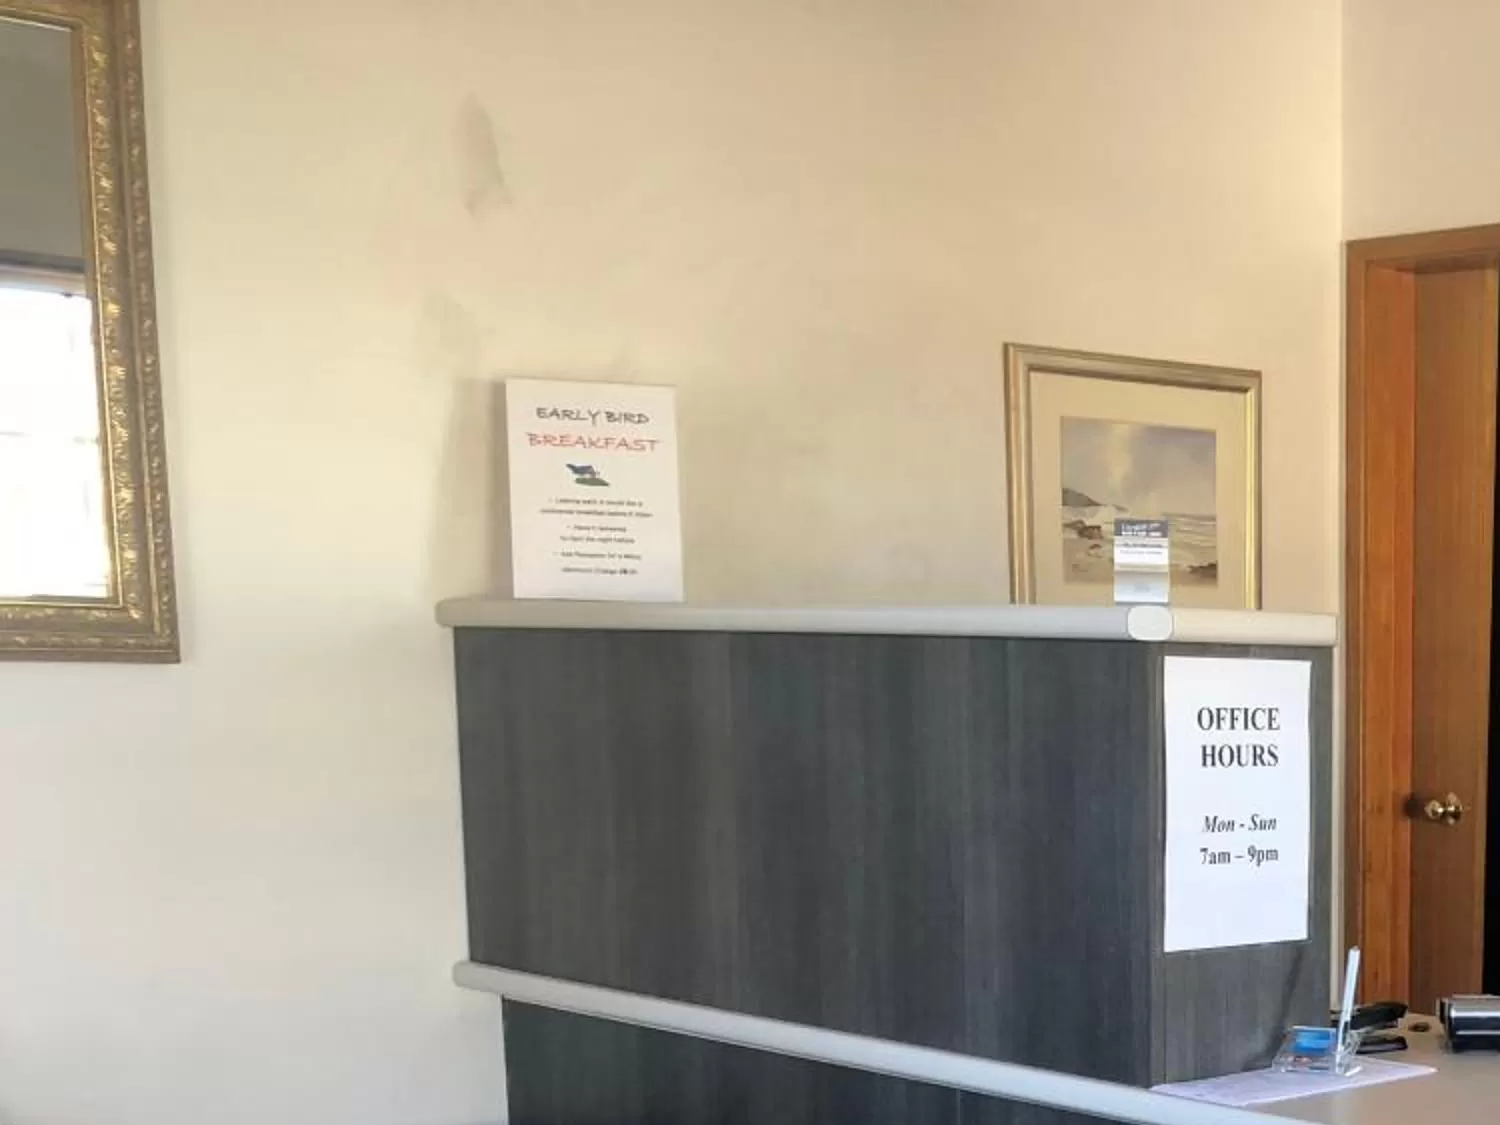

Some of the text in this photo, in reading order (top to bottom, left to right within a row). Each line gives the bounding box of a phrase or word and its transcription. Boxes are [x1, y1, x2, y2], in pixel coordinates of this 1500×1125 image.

[536, 407, 650, 426] EARLY BIRD
[526, 432, 662, 451] BREAKFAST
[1197, 707, 1280, 731] OFFICE
[1201, 744, 1279, 767] HOURS
[1202, 815, 1235, 833] Mon
[1247, 813, 1277, 831] Sun
[1200, 847, 1230, 864] 7am
[1247, 844, 1278, 867] 9pm
